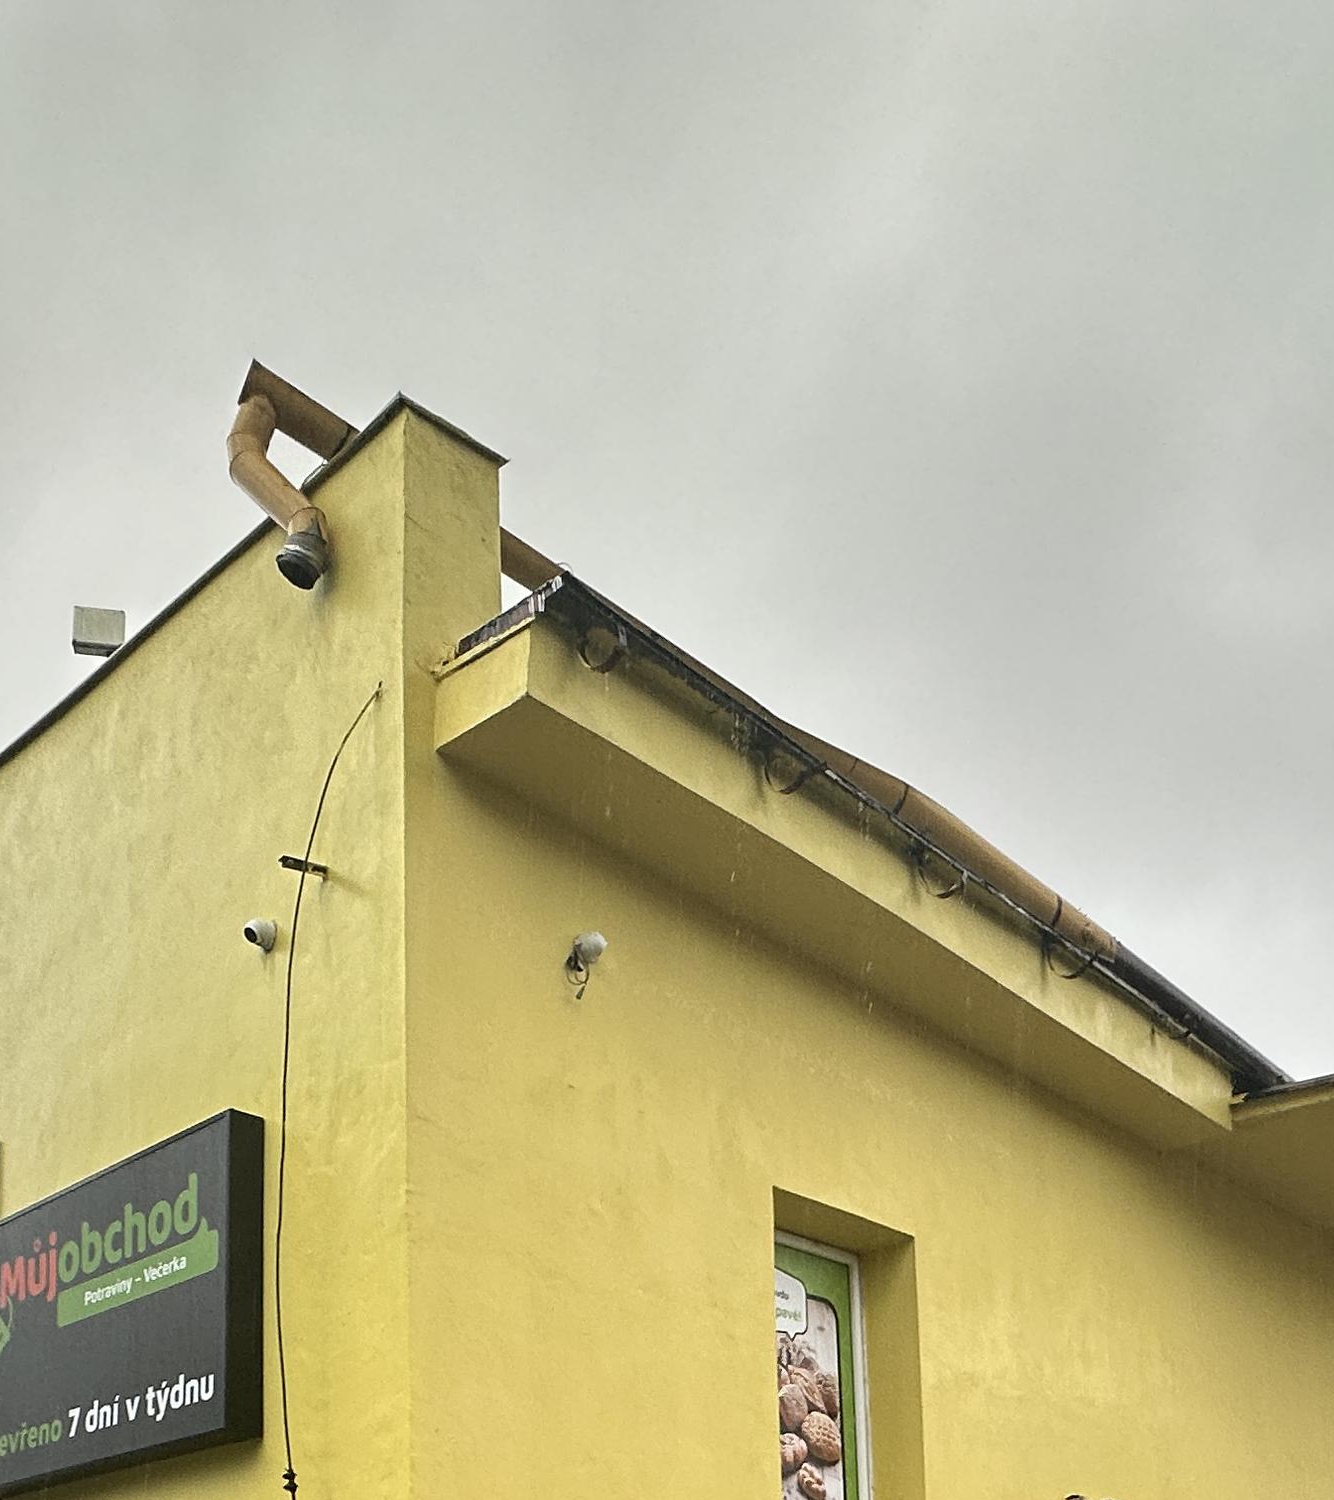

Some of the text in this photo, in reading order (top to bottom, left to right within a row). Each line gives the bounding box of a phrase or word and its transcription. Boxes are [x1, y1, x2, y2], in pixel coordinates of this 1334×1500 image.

[83, 1275, 133, 1306] Potraviny
[143, 1255, 187, 1283] Večerka
[68, 1407, 81, 1438] 7
[85, 1395, 119, 1433] dní
[125, 1396, 141, 1421] v
[145, 1373, 215, 1422] týdnu
